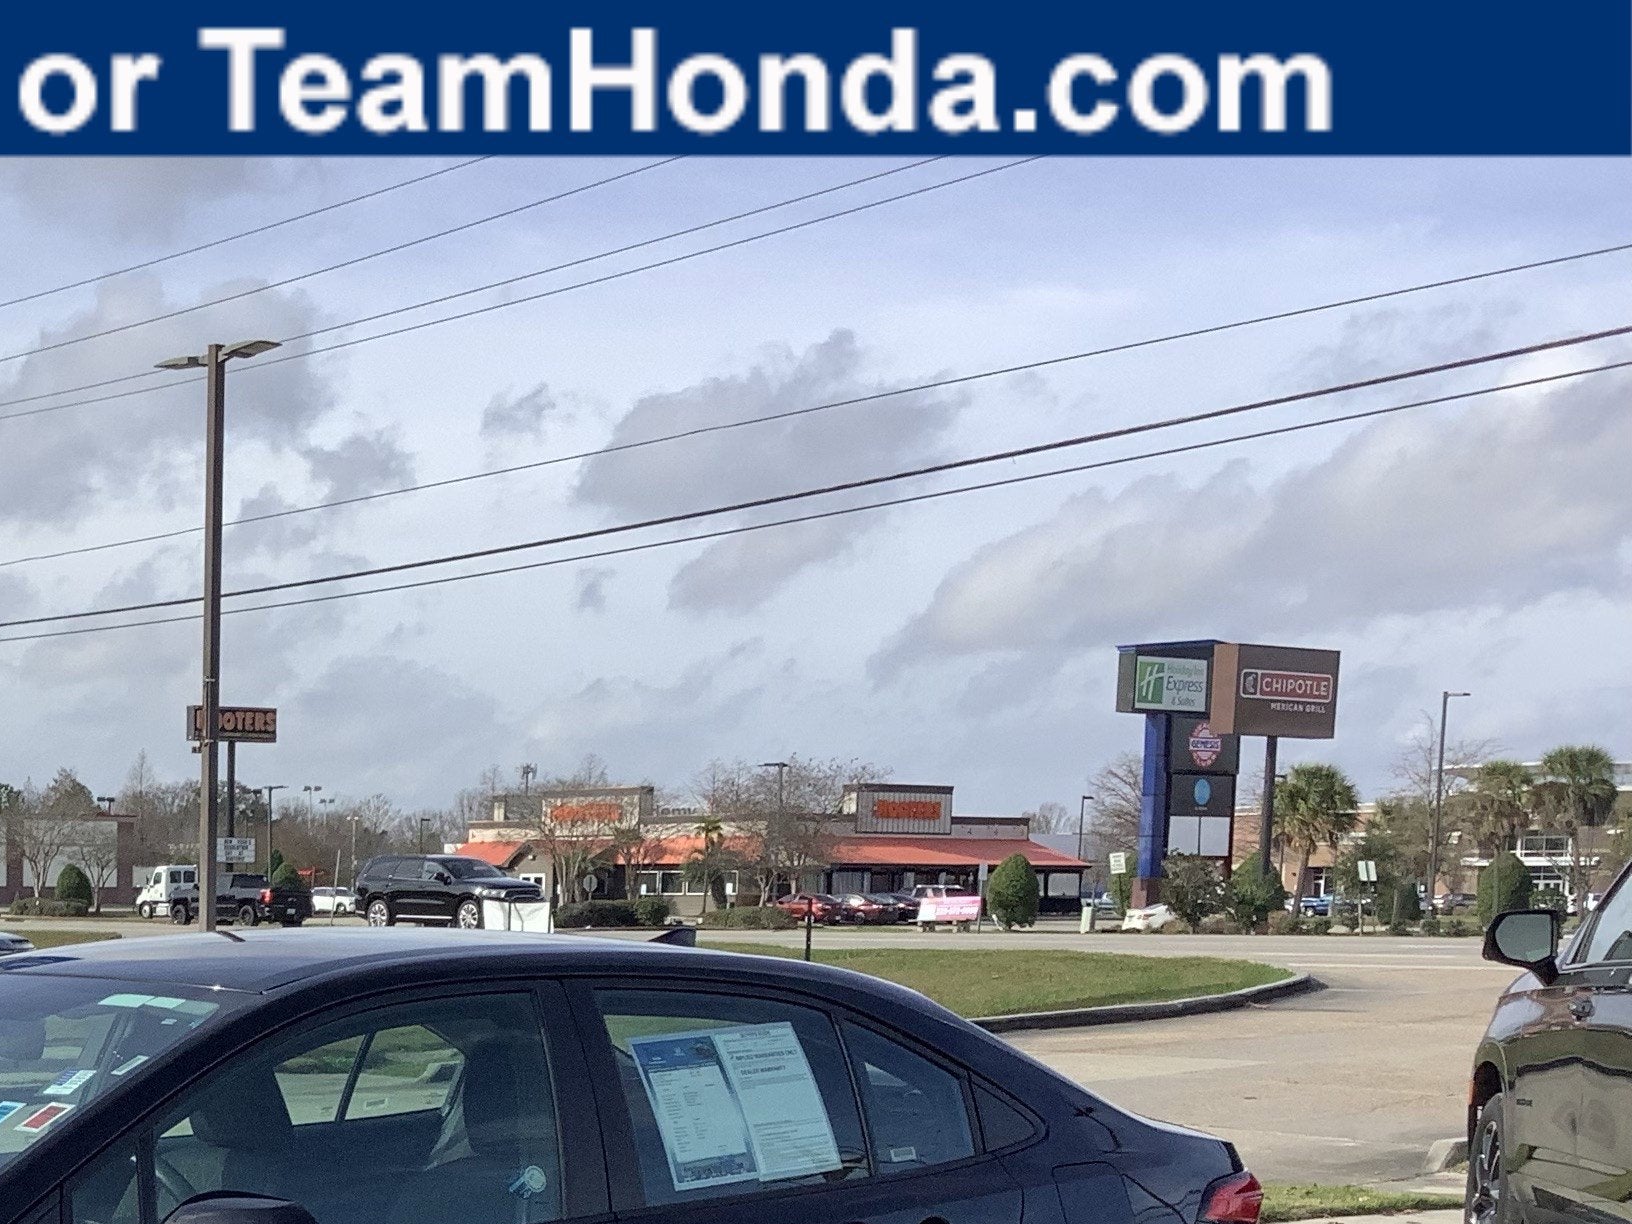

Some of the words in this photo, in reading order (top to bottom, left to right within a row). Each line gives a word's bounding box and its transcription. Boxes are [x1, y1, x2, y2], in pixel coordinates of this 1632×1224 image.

[1166, 675, 1204, 695] Express
[1262, 677, 1329, 696] CHIPOTLE
[1270, 701, 1304, 713] MEXICAN
